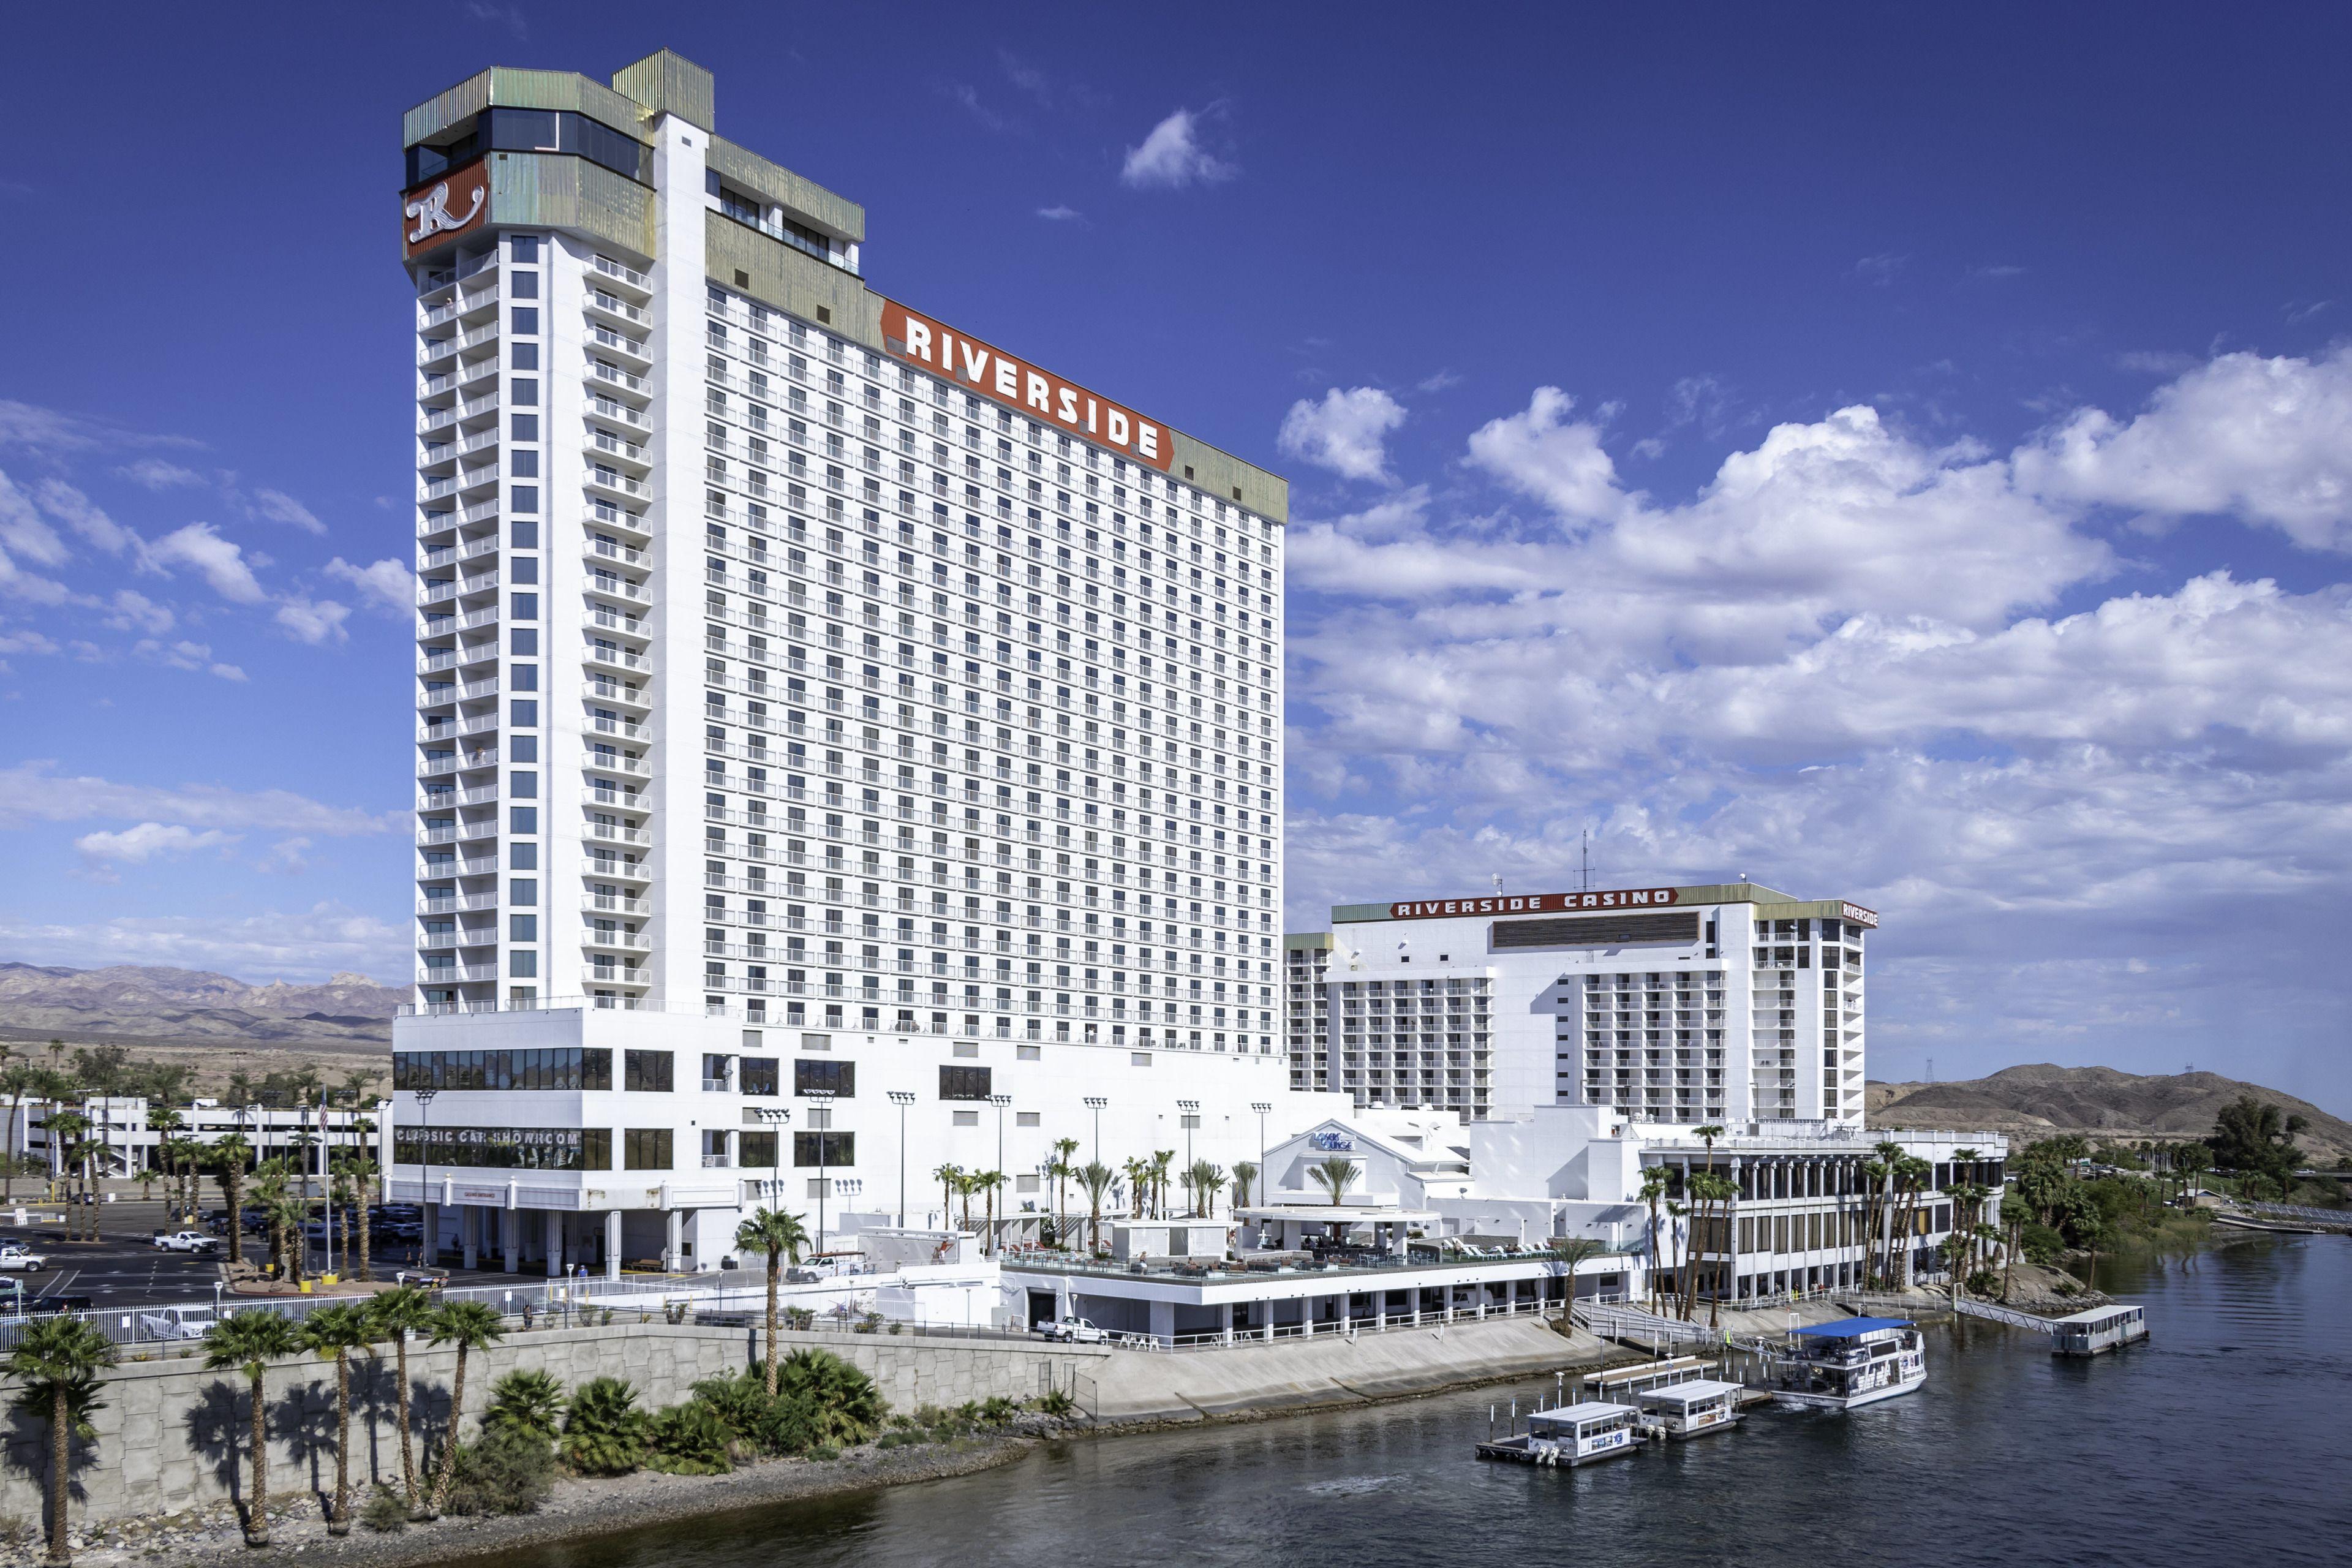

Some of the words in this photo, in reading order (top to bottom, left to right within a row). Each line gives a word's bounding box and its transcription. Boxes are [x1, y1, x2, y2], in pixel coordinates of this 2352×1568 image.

[905, 315, 1158, 460] RIVERSIDE
[1398, 897, 1540, 916] RIVERSIDE
[1564, 890, 1670, 908] CASINO
[1843, 903, 1878, 926] RIVERSIDE
[397, 1130, 453, 1142] CLASSIC
[459, 1131, 486, 1143] CAR
[493, 1132, 578, 1145] SHOWROOM
